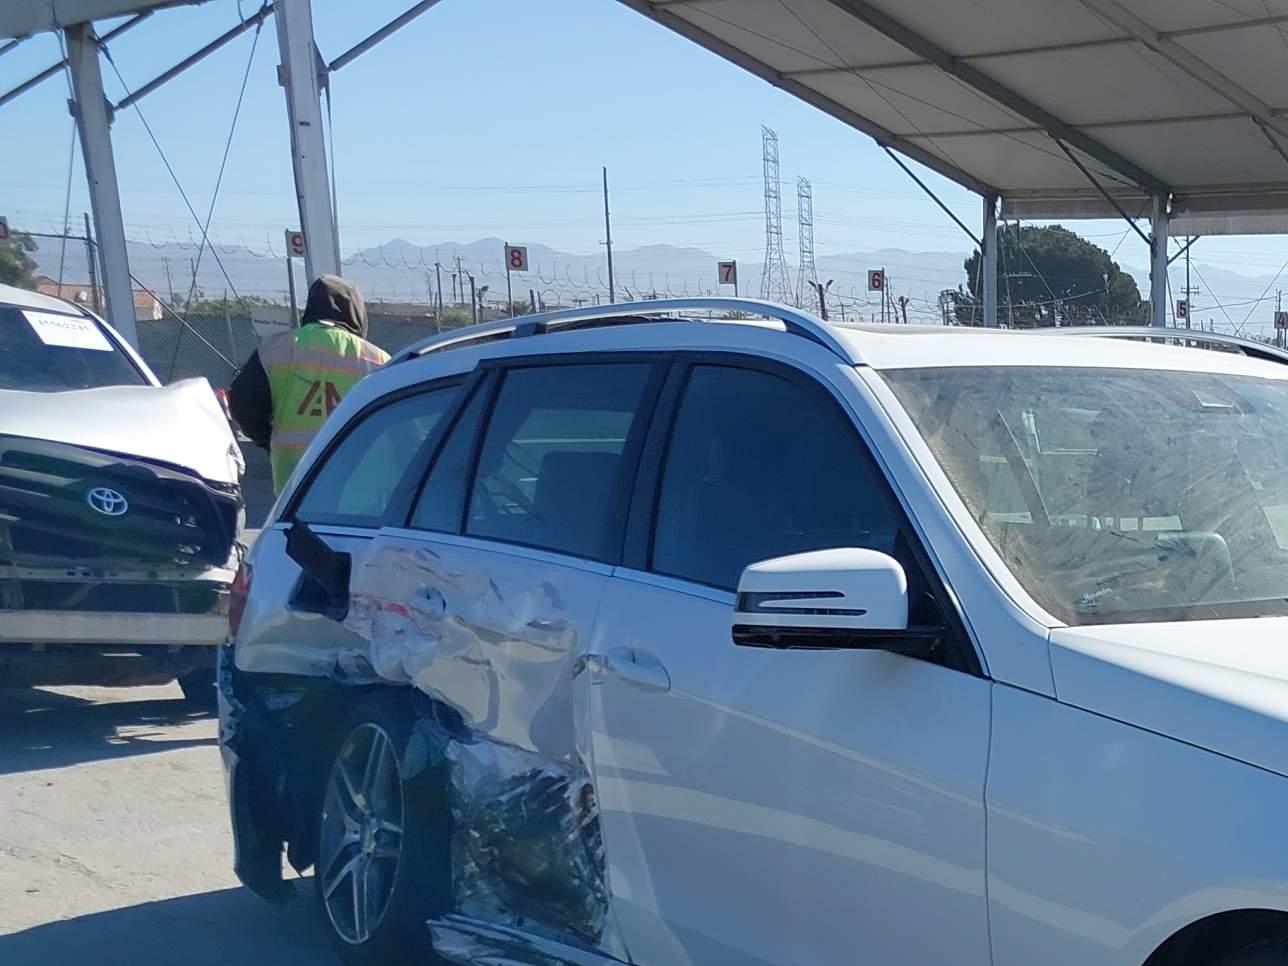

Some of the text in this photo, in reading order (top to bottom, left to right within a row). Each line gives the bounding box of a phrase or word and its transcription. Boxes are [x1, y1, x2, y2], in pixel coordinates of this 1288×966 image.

[291, 234, 304, 255] 9
[510, 249, 522, 268] 8
[721, 264, 733, 282] 7
[871, 272, 881, 289] 6
[1179, 302, 1187, 317] 5
[1277, 313, 1286, 328] 4
